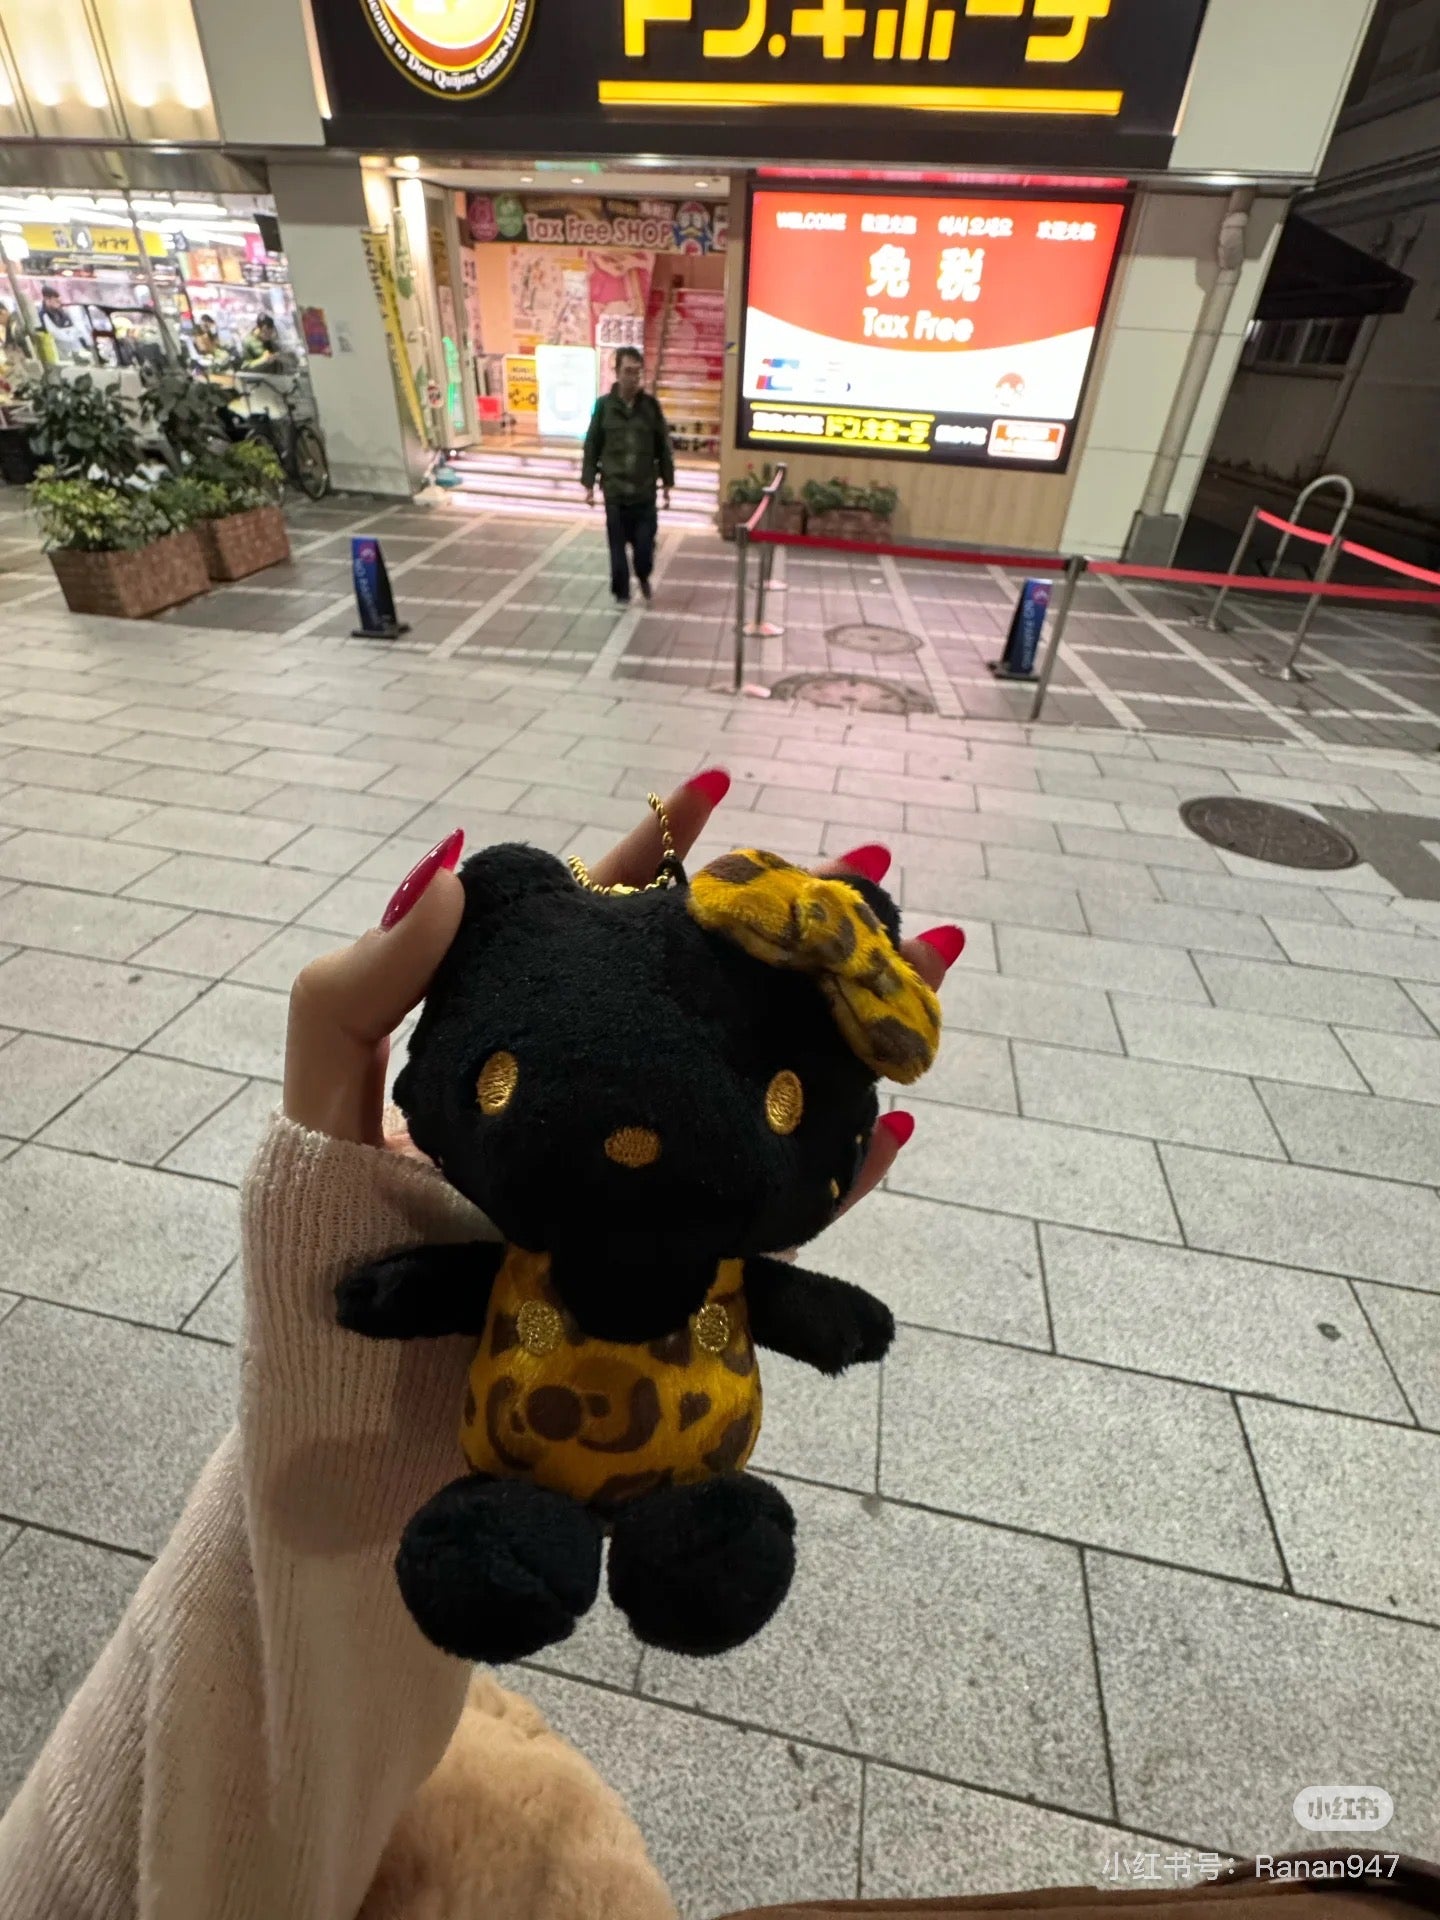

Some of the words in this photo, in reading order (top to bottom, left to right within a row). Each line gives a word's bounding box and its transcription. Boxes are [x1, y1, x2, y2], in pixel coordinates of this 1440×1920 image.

[393, 43, 408, 60] to
[406, 54, 433, 82] Don
[525, 212, 565, 242] Tax
[565, 215, 612, 244] Free
[612, 217, 675, 248] SHOP
[776, 212, 847, 231] WELCOME
[862, 307, 909, 339] Tax
[913, 310, 974, 342] Free
